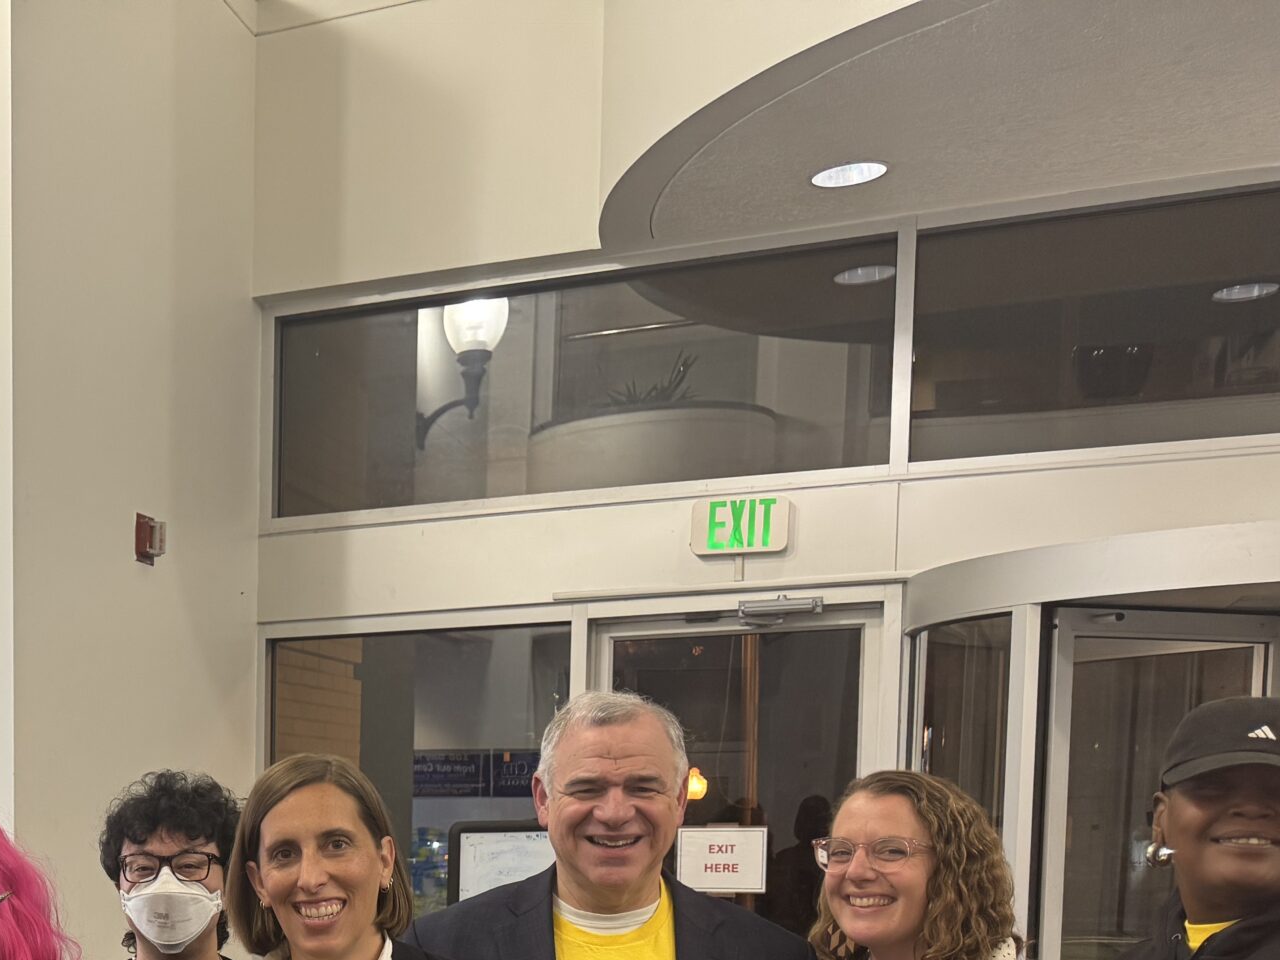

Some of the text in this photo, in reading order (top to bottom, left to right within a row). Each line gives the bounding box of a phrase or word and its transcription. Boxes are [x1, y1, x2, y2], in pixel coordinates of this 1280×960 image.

[706, 498, 777, 550] EXIT
[708, 844, 737, 854] EXIT
[704, 863, 739, 873] HERE
